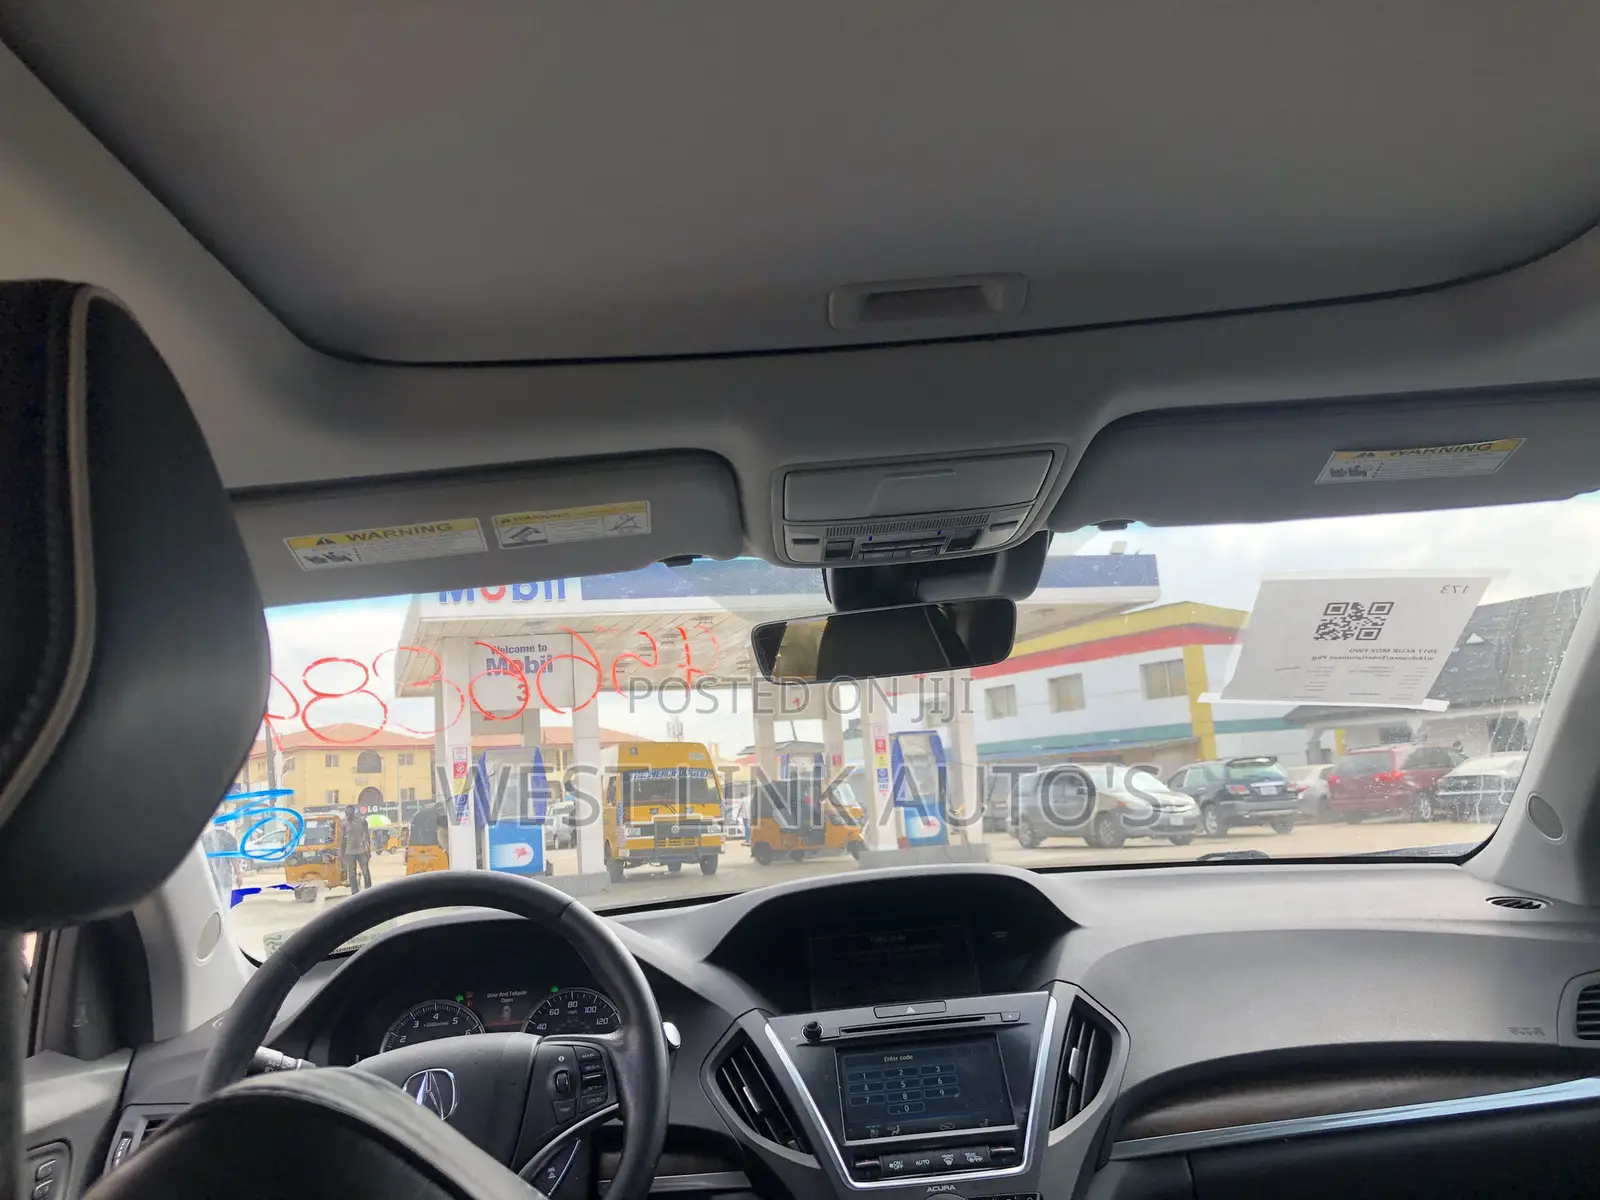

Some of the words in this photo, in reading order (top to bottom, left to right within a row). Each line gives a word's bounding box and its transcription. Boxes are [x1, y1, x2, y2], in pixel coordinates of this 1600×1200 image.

[1389, 443, 1494, 457] WARNING
[345, 522, 453, 542] WARNING
[490, 643, 536, 656] Welcome
[537, 643, 548, 653] to
[486, 655, 554, 677] Mobil
[567, 1000, 578, 1008] 80
[549, 1008, 560, 1016] 60
[584, 1006, 597, 1014] 100
[413, 1020, 420, 1028] 3
[452, 1016, 459, 1025] 5
[596, 1017, 609, 1026] 120
[536, 1022, 548, 1031] 40
[400, 1035, 407, 1043] 2
[883, 1055, 899, 1063] Enter
[899, 1053, 914, 1061] code
[862, 1072, 868, 1080] 1
[935, 1065, 941, 1073] 3
[900, 1080, 906, 1088] 5
[937, 1077, 943, 1085] 6
[864, 1096, 870, 1104] 7
[902, 1092, 908, 1100] 8
[939, 1089, 945, 1097] 9
[904, 1104, 910, 1112] 0
[926, 1184, 956, 1193] ACURA
